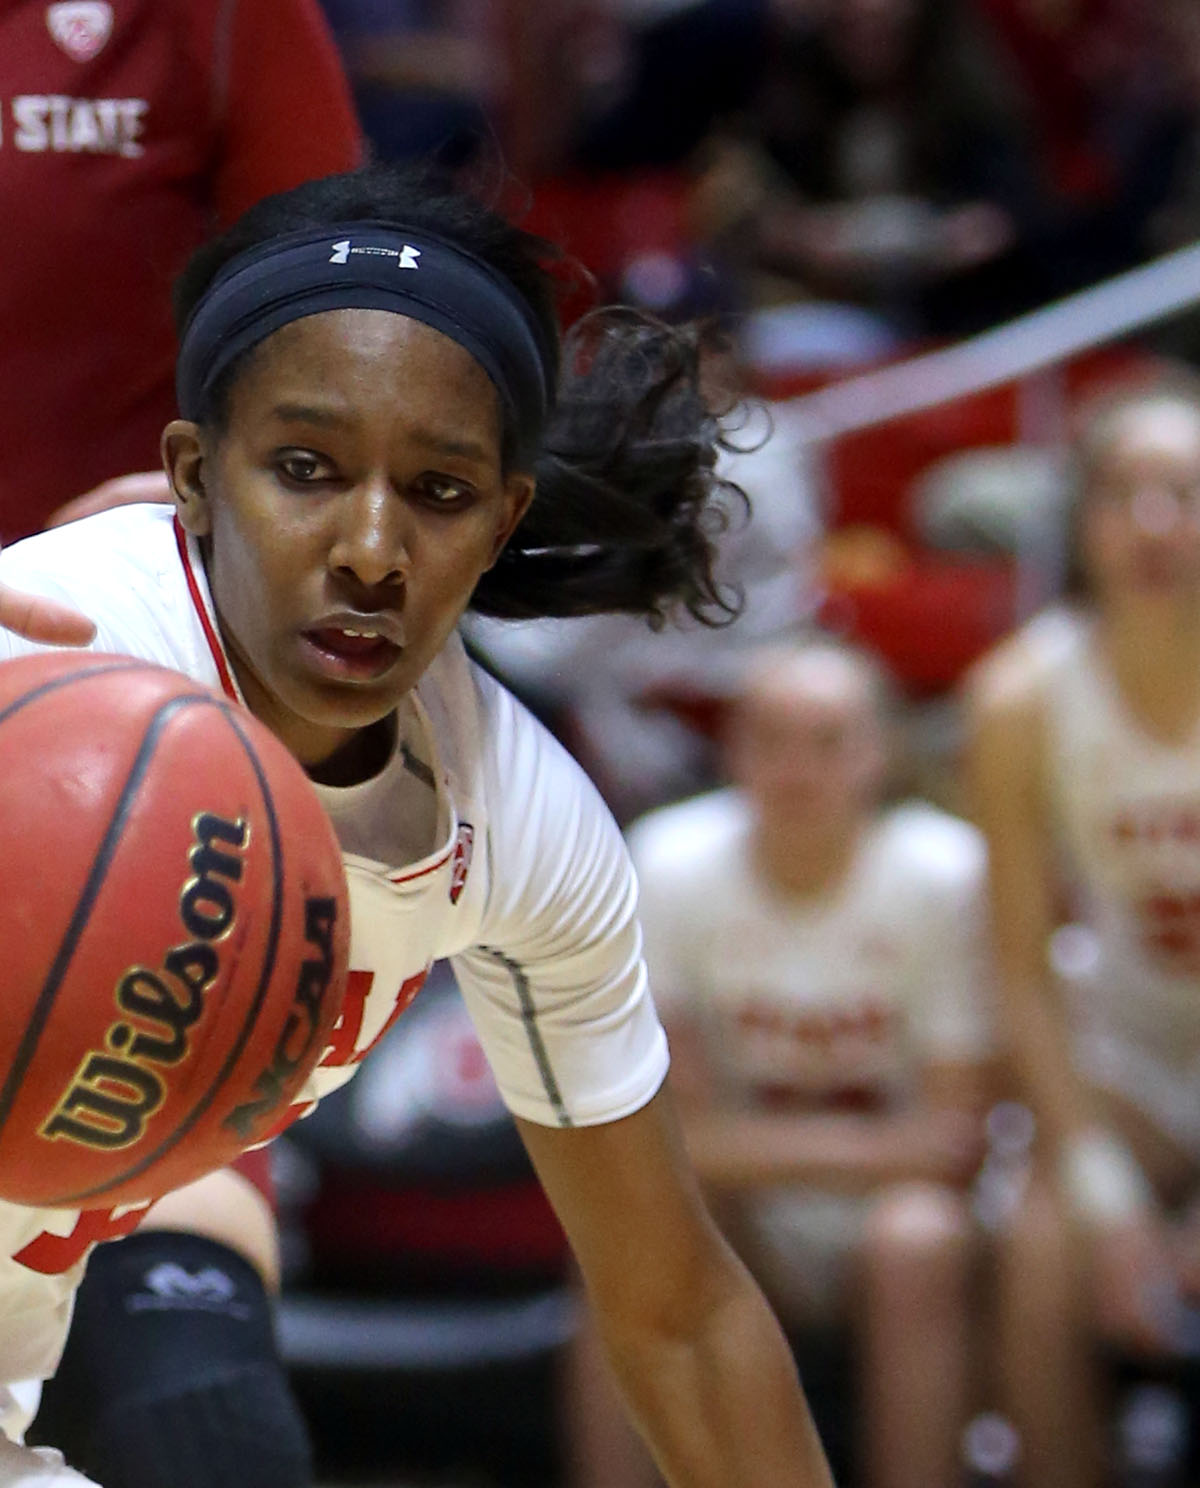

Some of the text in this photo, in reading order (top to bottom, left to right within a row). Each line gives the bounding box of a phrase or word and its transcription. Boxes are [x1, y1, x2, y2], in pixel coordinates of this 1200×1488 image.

[13, 95, 148, 158] STATE
[36, 811, 250, 1151] Wilson
[220, 898, 336, 1138] NCAA
